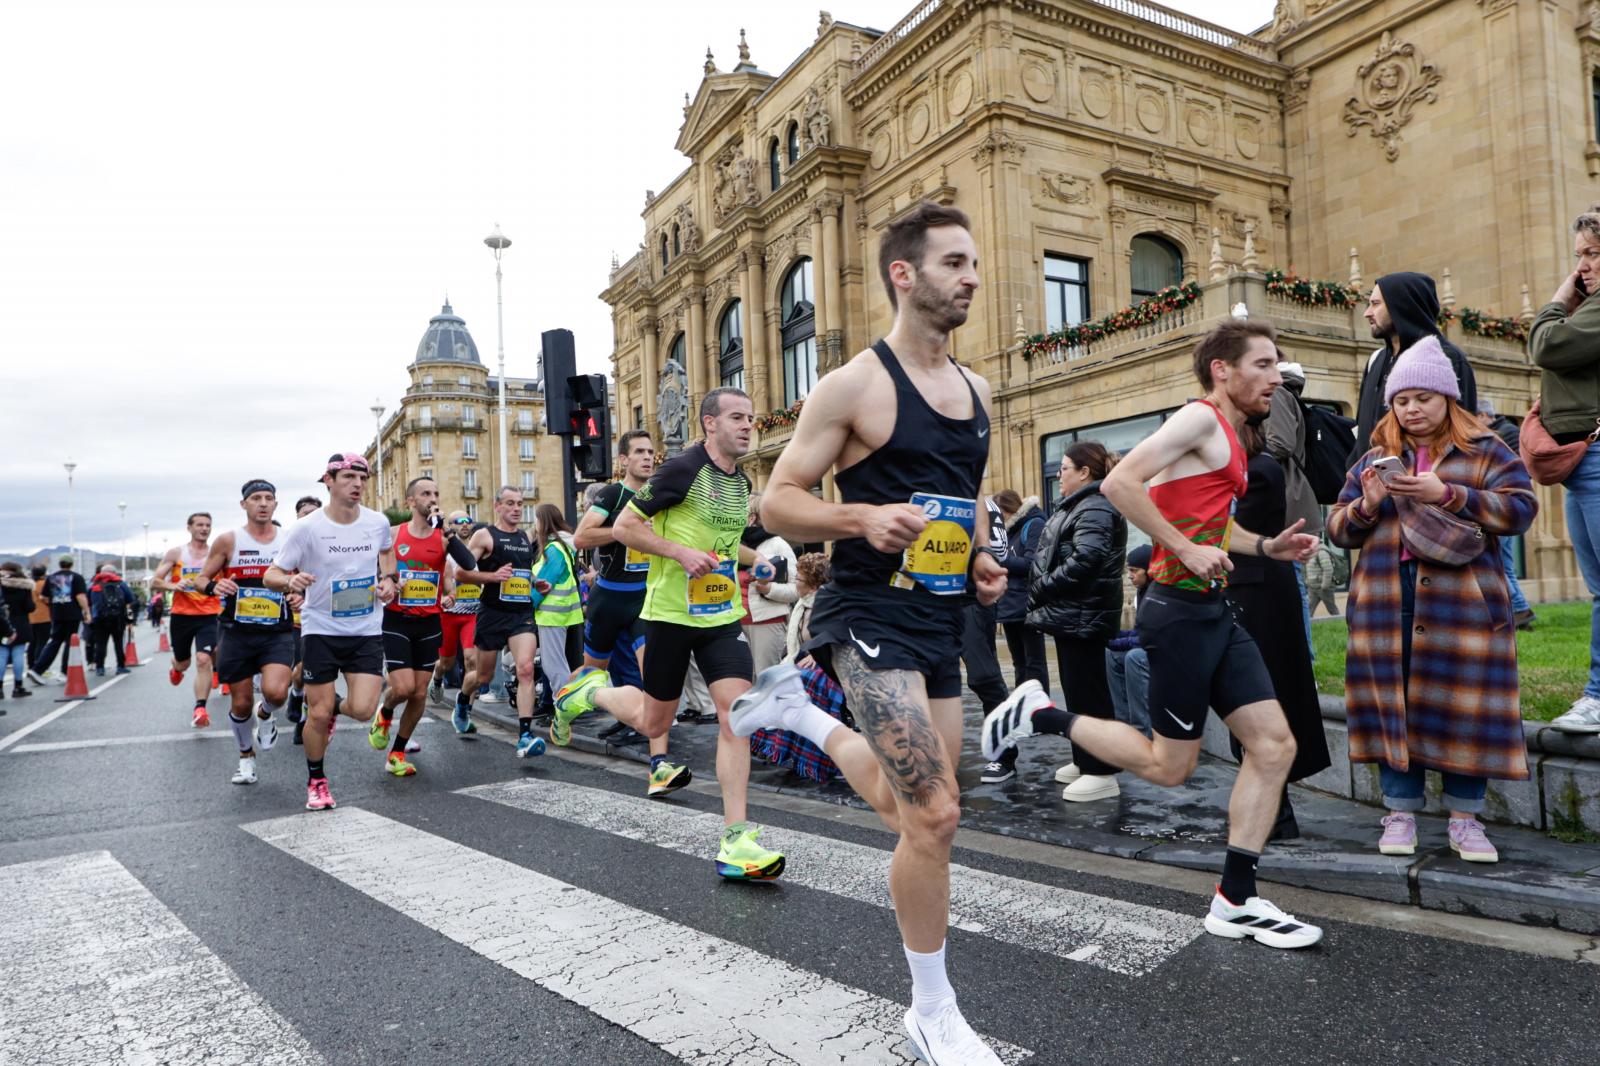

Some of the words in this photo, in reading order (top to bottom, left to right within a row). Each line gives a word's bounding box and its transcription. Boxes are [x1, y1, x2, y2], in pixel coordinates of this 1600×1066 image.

[944, 506, 974, 519] ZURICH
[922, 539, 968, 554] ALVARO
[705, 583, 728, 593] EDER
